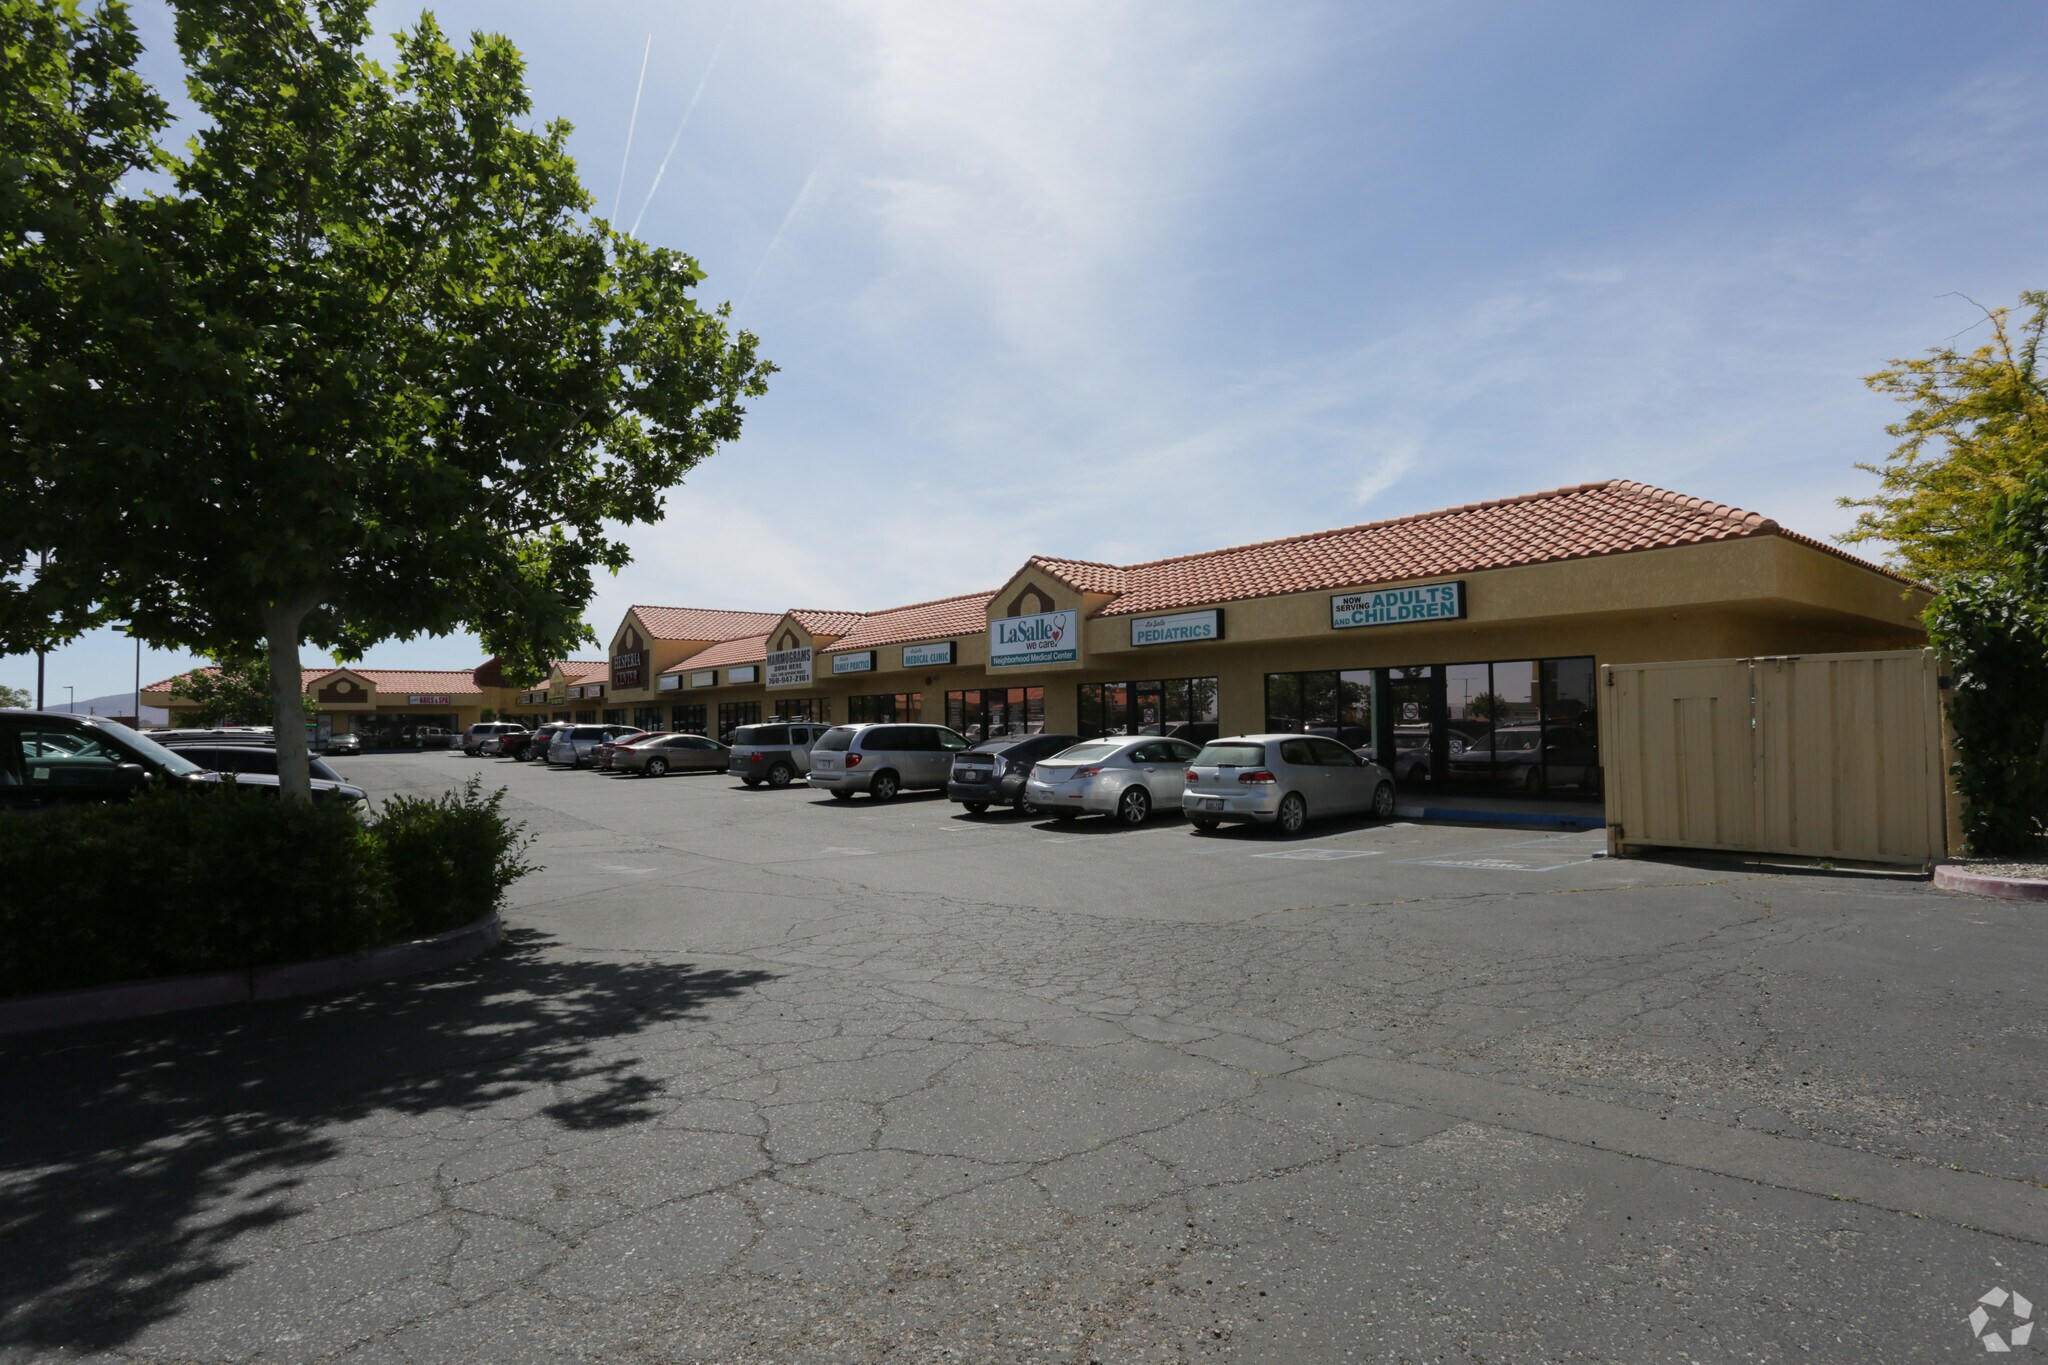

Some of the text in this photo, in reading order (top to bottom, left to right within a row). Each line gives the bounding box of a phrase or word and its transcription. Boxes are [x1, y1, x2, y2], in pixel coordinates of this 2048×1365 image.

[1343, 597, 1361, 605] NOW
[1372, 587, 1454, 608] ADULTS
[1334, 602, 1455, 626] AND CHILDREN
[1336, 602, 1370, 612] SERVING
[999, 619, 1052, 644] LaSalle
[1137, 624, 1211, 643] PEDIATRICS
[1026, 640, 1054, 650] we care
[613, 652, 641, 670] HESPERIA
[767, 649, 811, 666] MAMMOGRAMS
[850, 660, 870, 670] PRACTICE
[905, 651, 949, 665] MEDICAL CLINIC
[993, 651, 1073, 666] Neighborhood Medical Center
[616, 670, 638, 686] CENTER
[768, 674, 810, 685] 760-947-2161
[419, 696, 434, 704] NAILS
[438, 696, 449, 704] SPA
